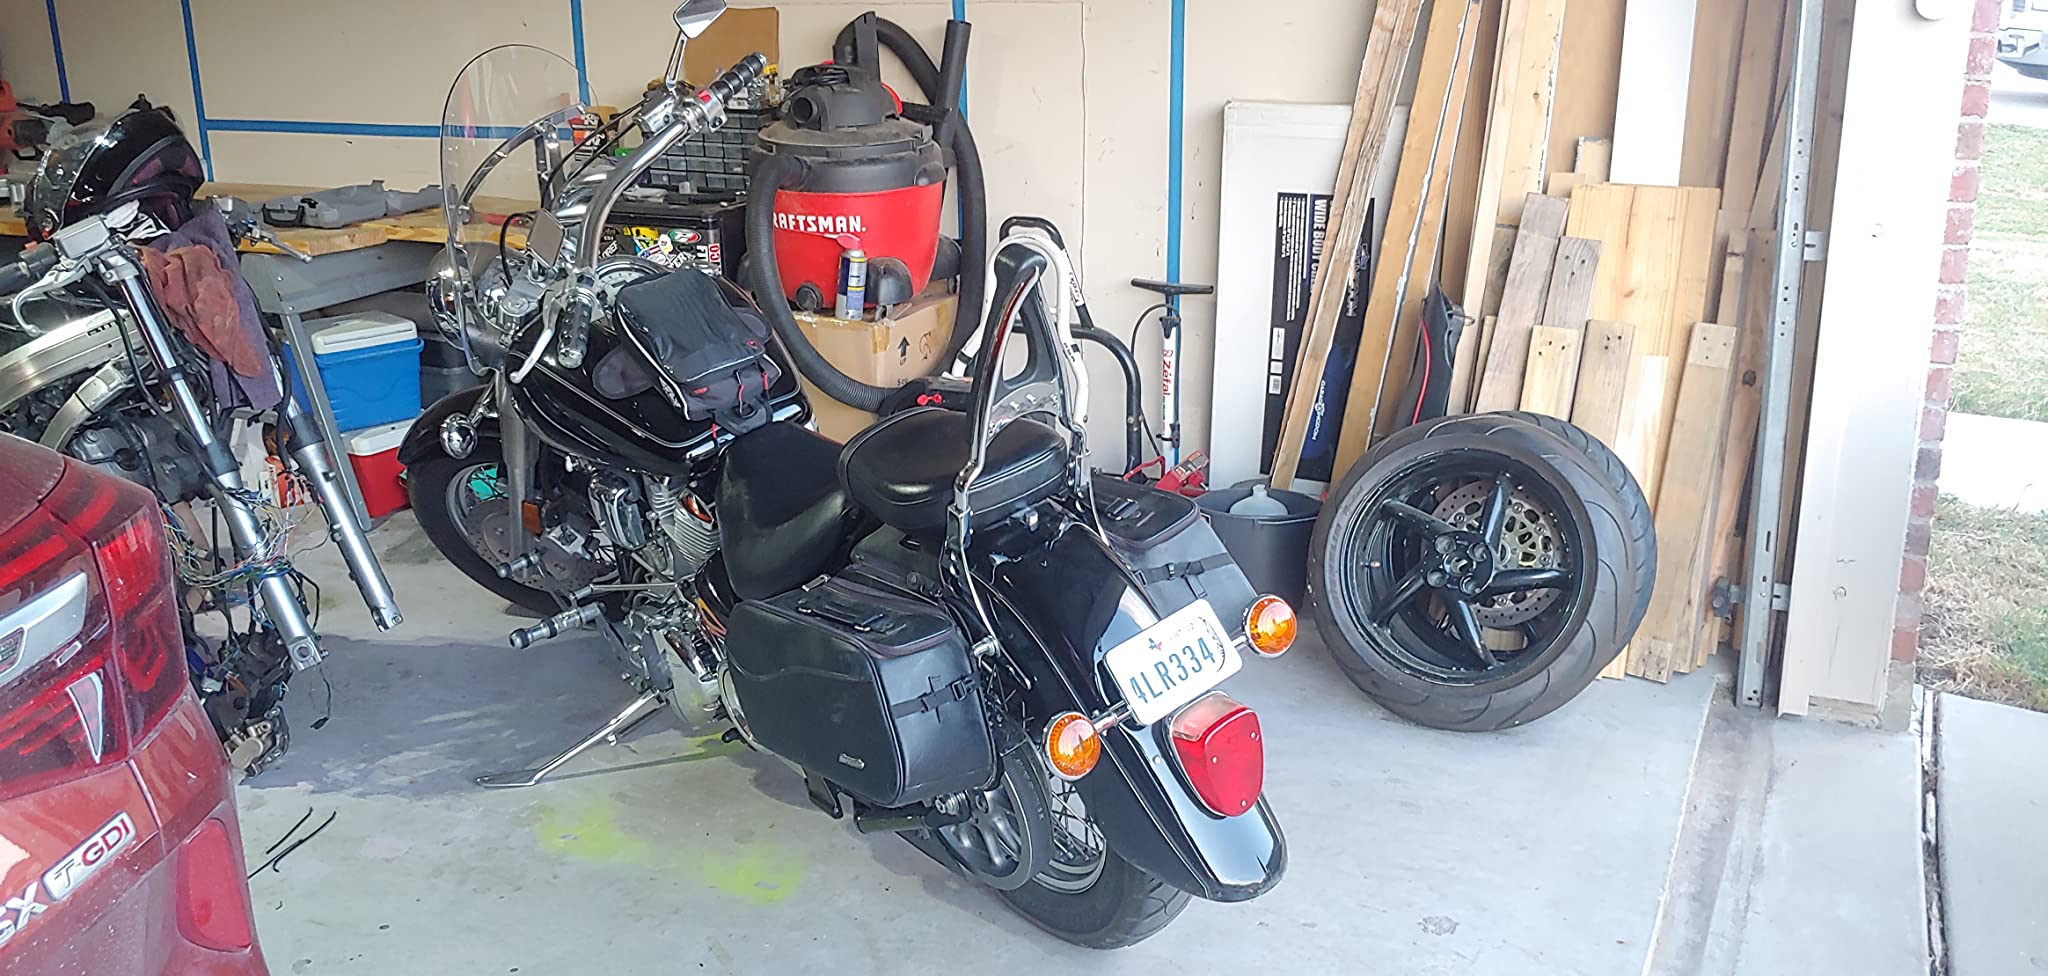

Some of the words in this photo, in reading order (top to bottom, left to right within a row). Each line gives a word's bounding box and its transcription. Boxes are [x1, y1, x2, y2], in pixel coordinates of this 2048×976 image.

[1313, 199, 1328, 230] WIDE
[1163, 360, 1171, 396] Zéfal
[1130, 637, 1216, 704] 4LR334
[53, 818, 132, 890] T-GDI
